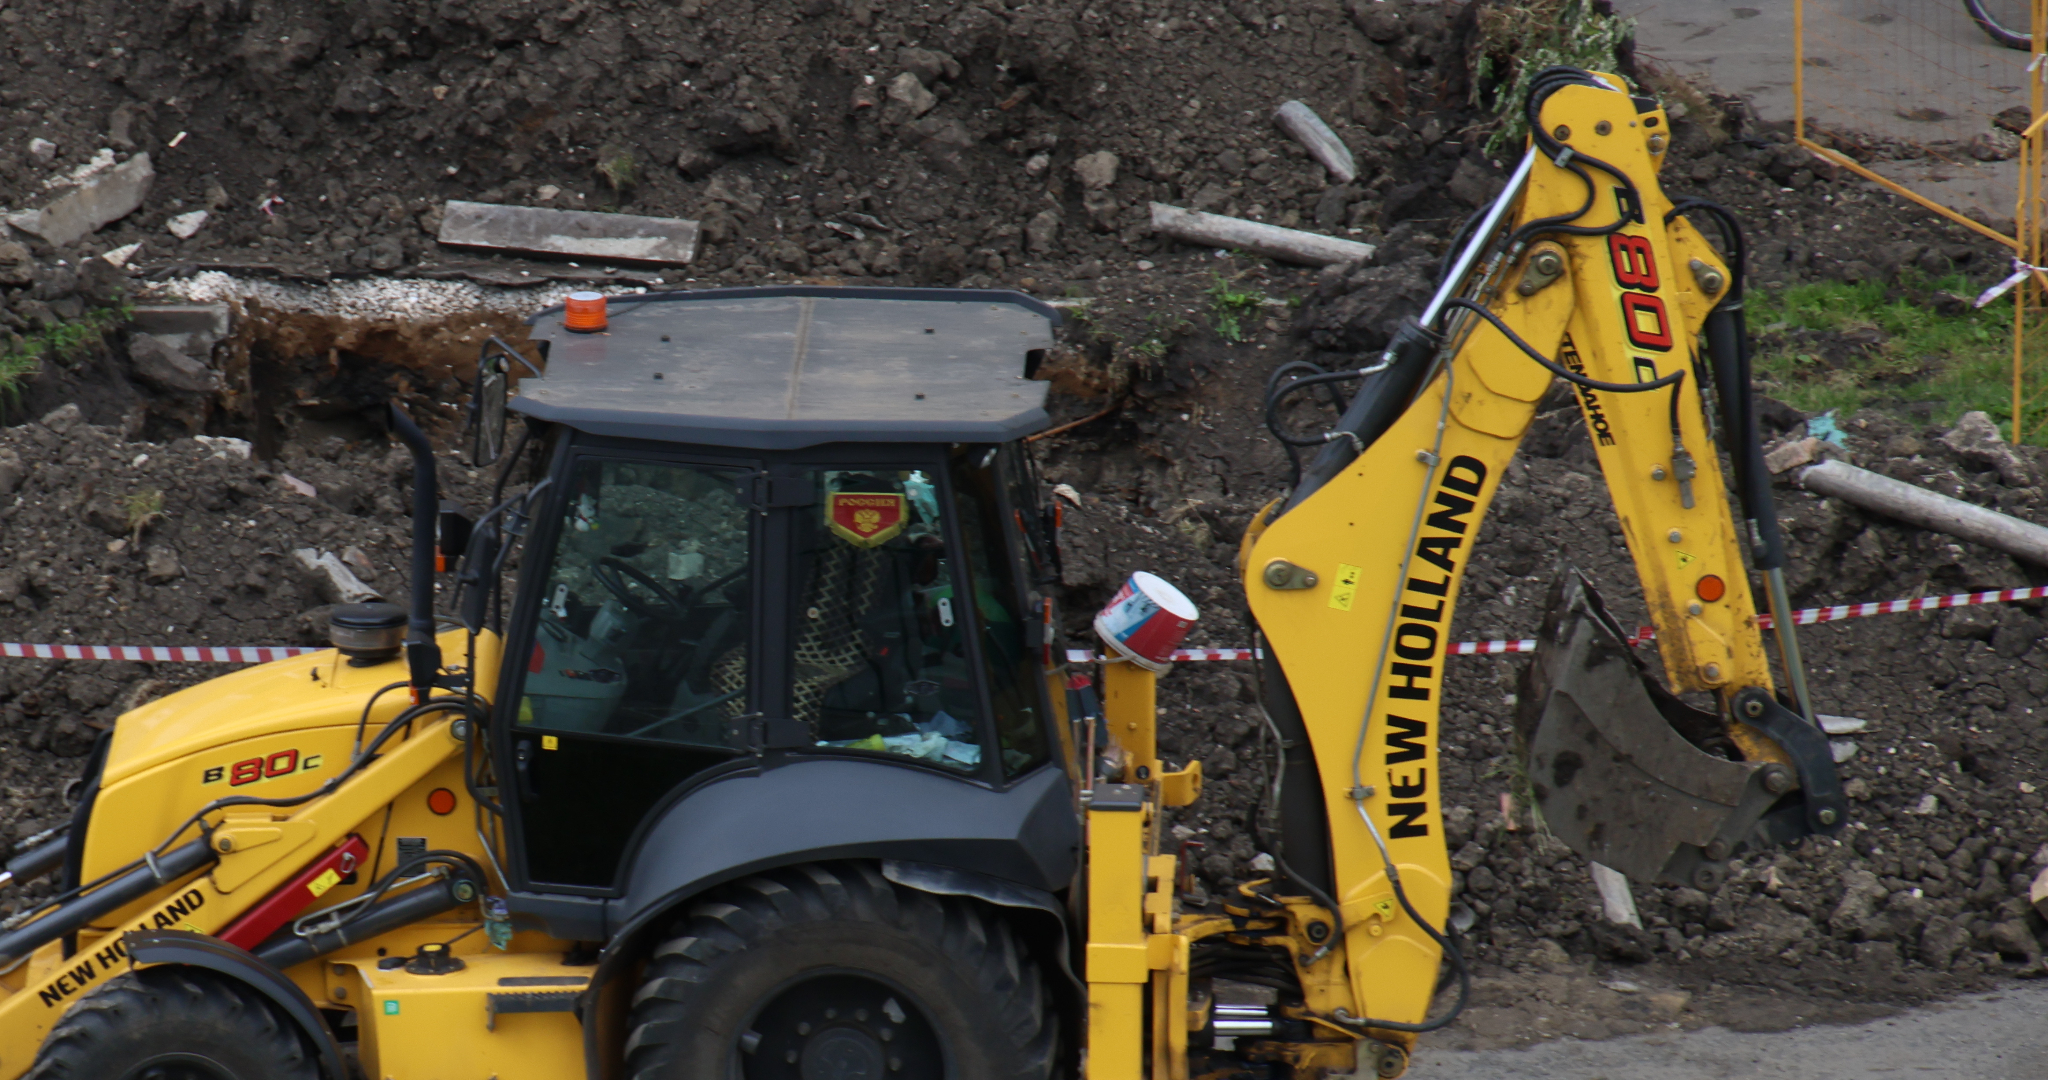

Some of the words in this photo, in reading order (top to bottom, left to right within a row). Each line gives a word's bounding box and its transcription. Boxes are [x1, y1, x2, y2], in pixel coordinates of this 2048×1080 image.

[1388, 455, 1487, 700] HOLLAND
[1385, 714, 1428, 839] NEW
[38, 960, 96, 1008] NEW
[95, 889, 205, 970] HOAND
